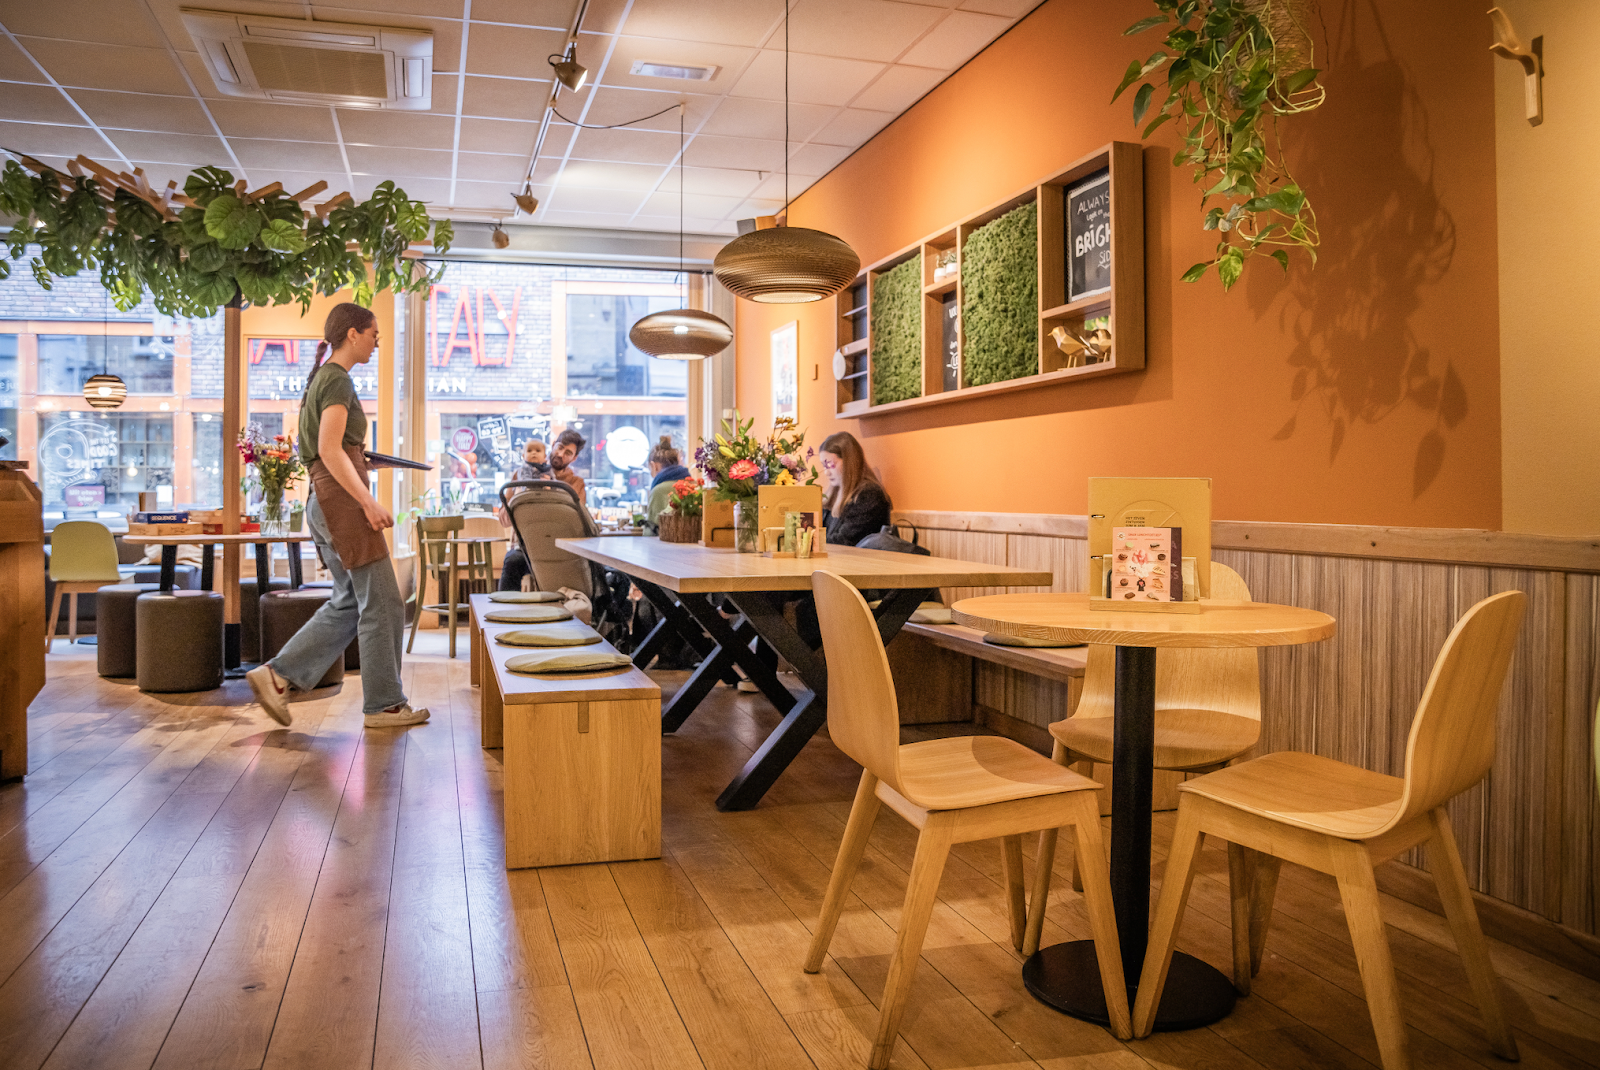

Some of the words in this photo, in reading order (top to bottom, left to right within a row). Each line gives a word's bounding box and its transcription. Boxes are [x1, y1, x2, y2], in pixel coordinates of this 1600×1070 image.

[1077, 190, 1110, 215] ALWAYS
[429, 284, 523, 367] TALY
[276, 376, 302, 391] TH
[353, 376, 375, 391] ST
